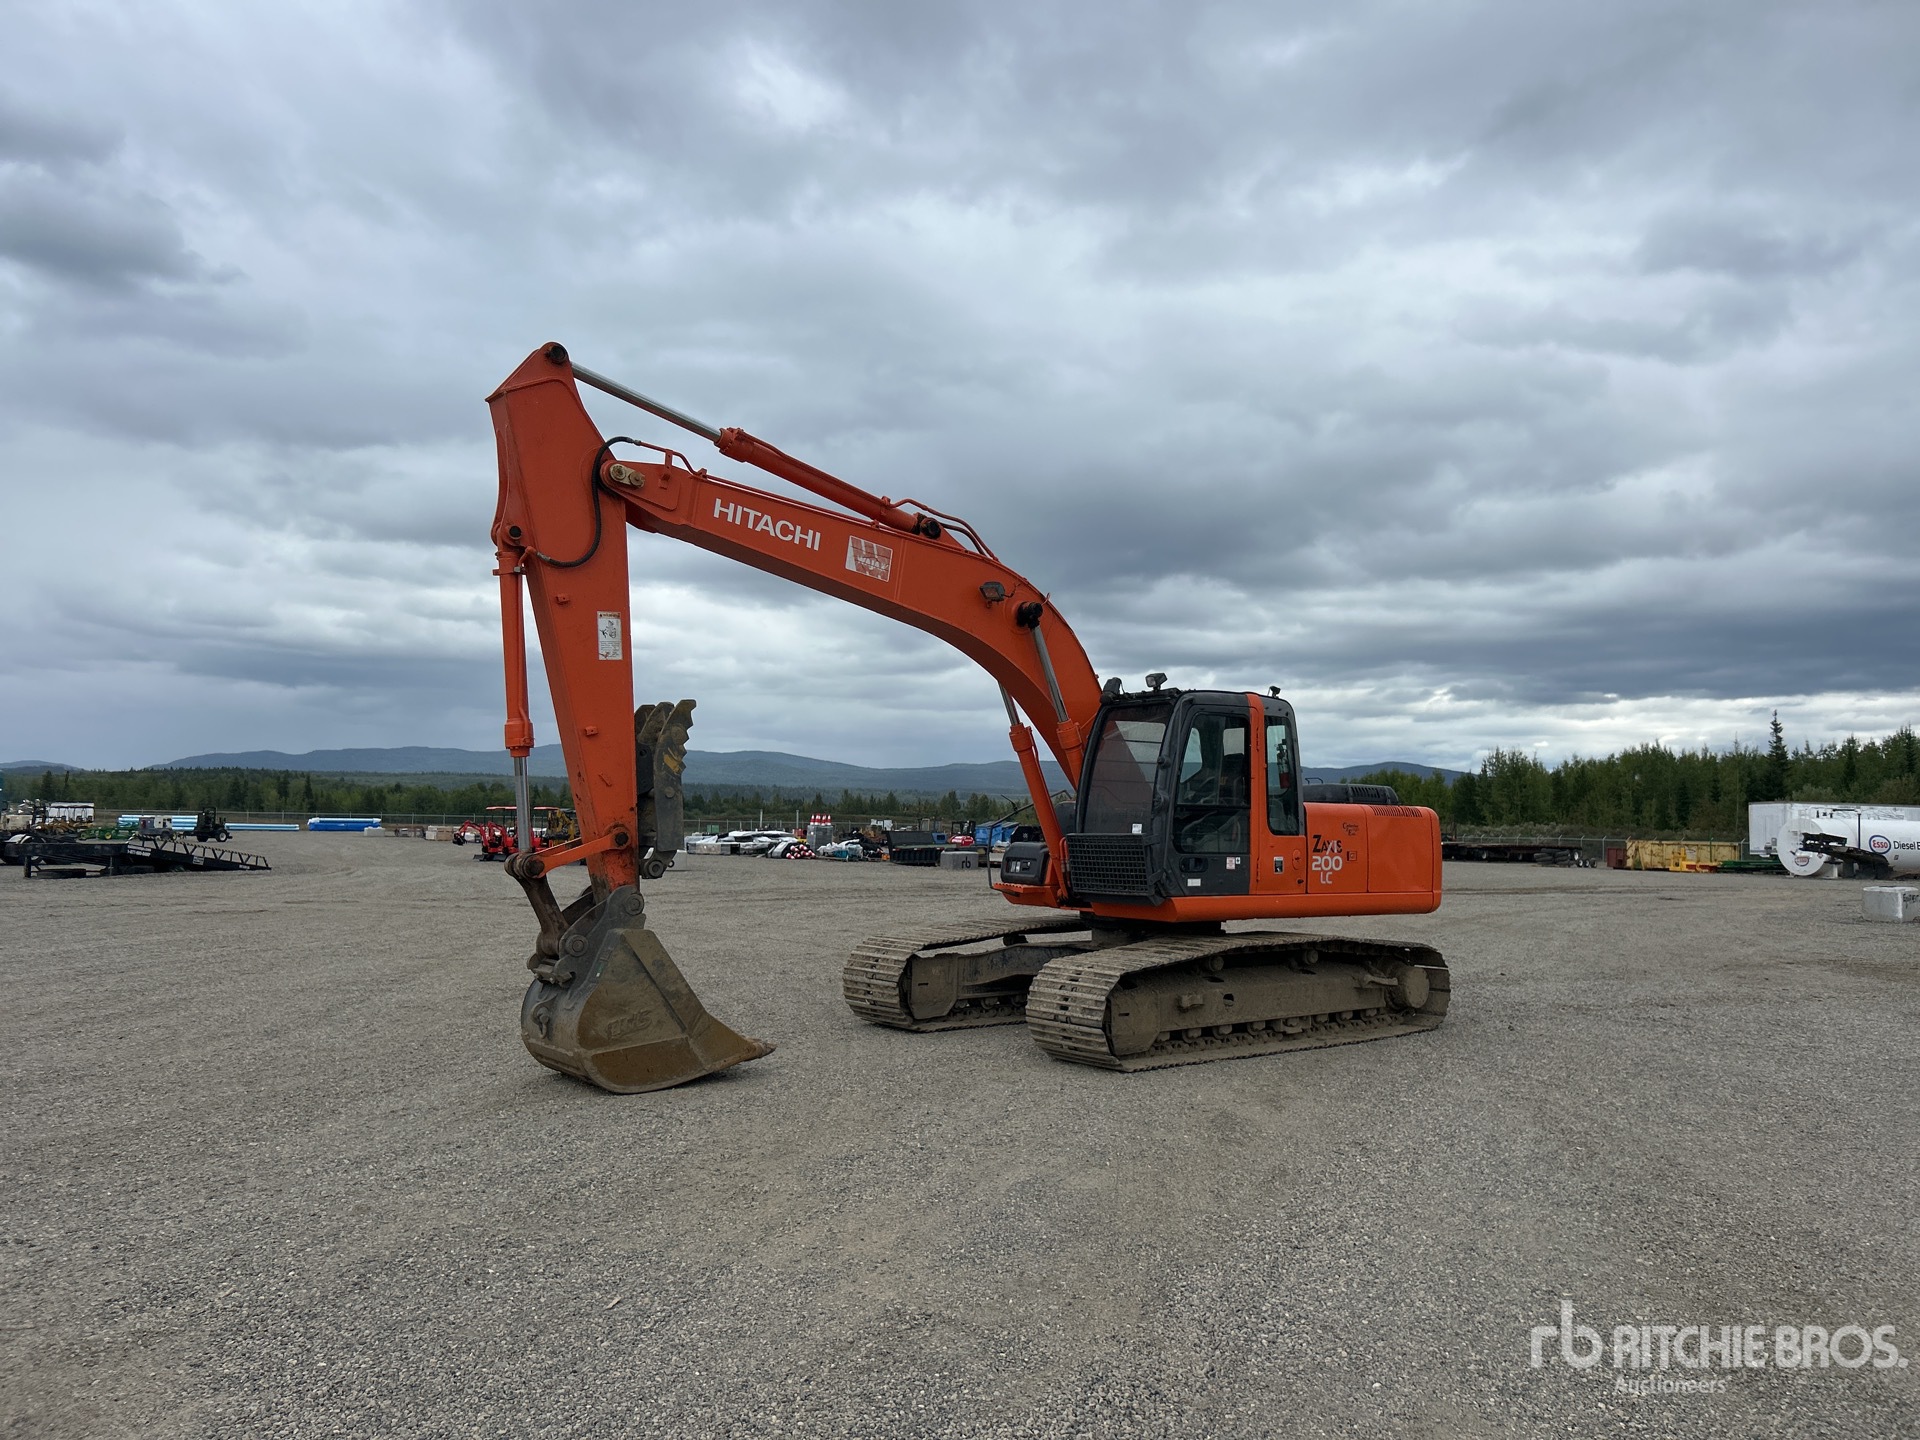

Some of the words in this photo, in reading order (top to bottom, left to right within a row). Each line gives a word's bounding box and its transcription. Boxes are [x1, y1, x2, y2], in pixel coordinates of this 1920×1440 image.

[713, 498, 821, 551] HITACHI
[1893, 840, 1916, 850] Diesel
[961, 856, 971, 869] rb
[1311, 855, 1343, 871] 200
[1320, 871, 1333, 884] LC
